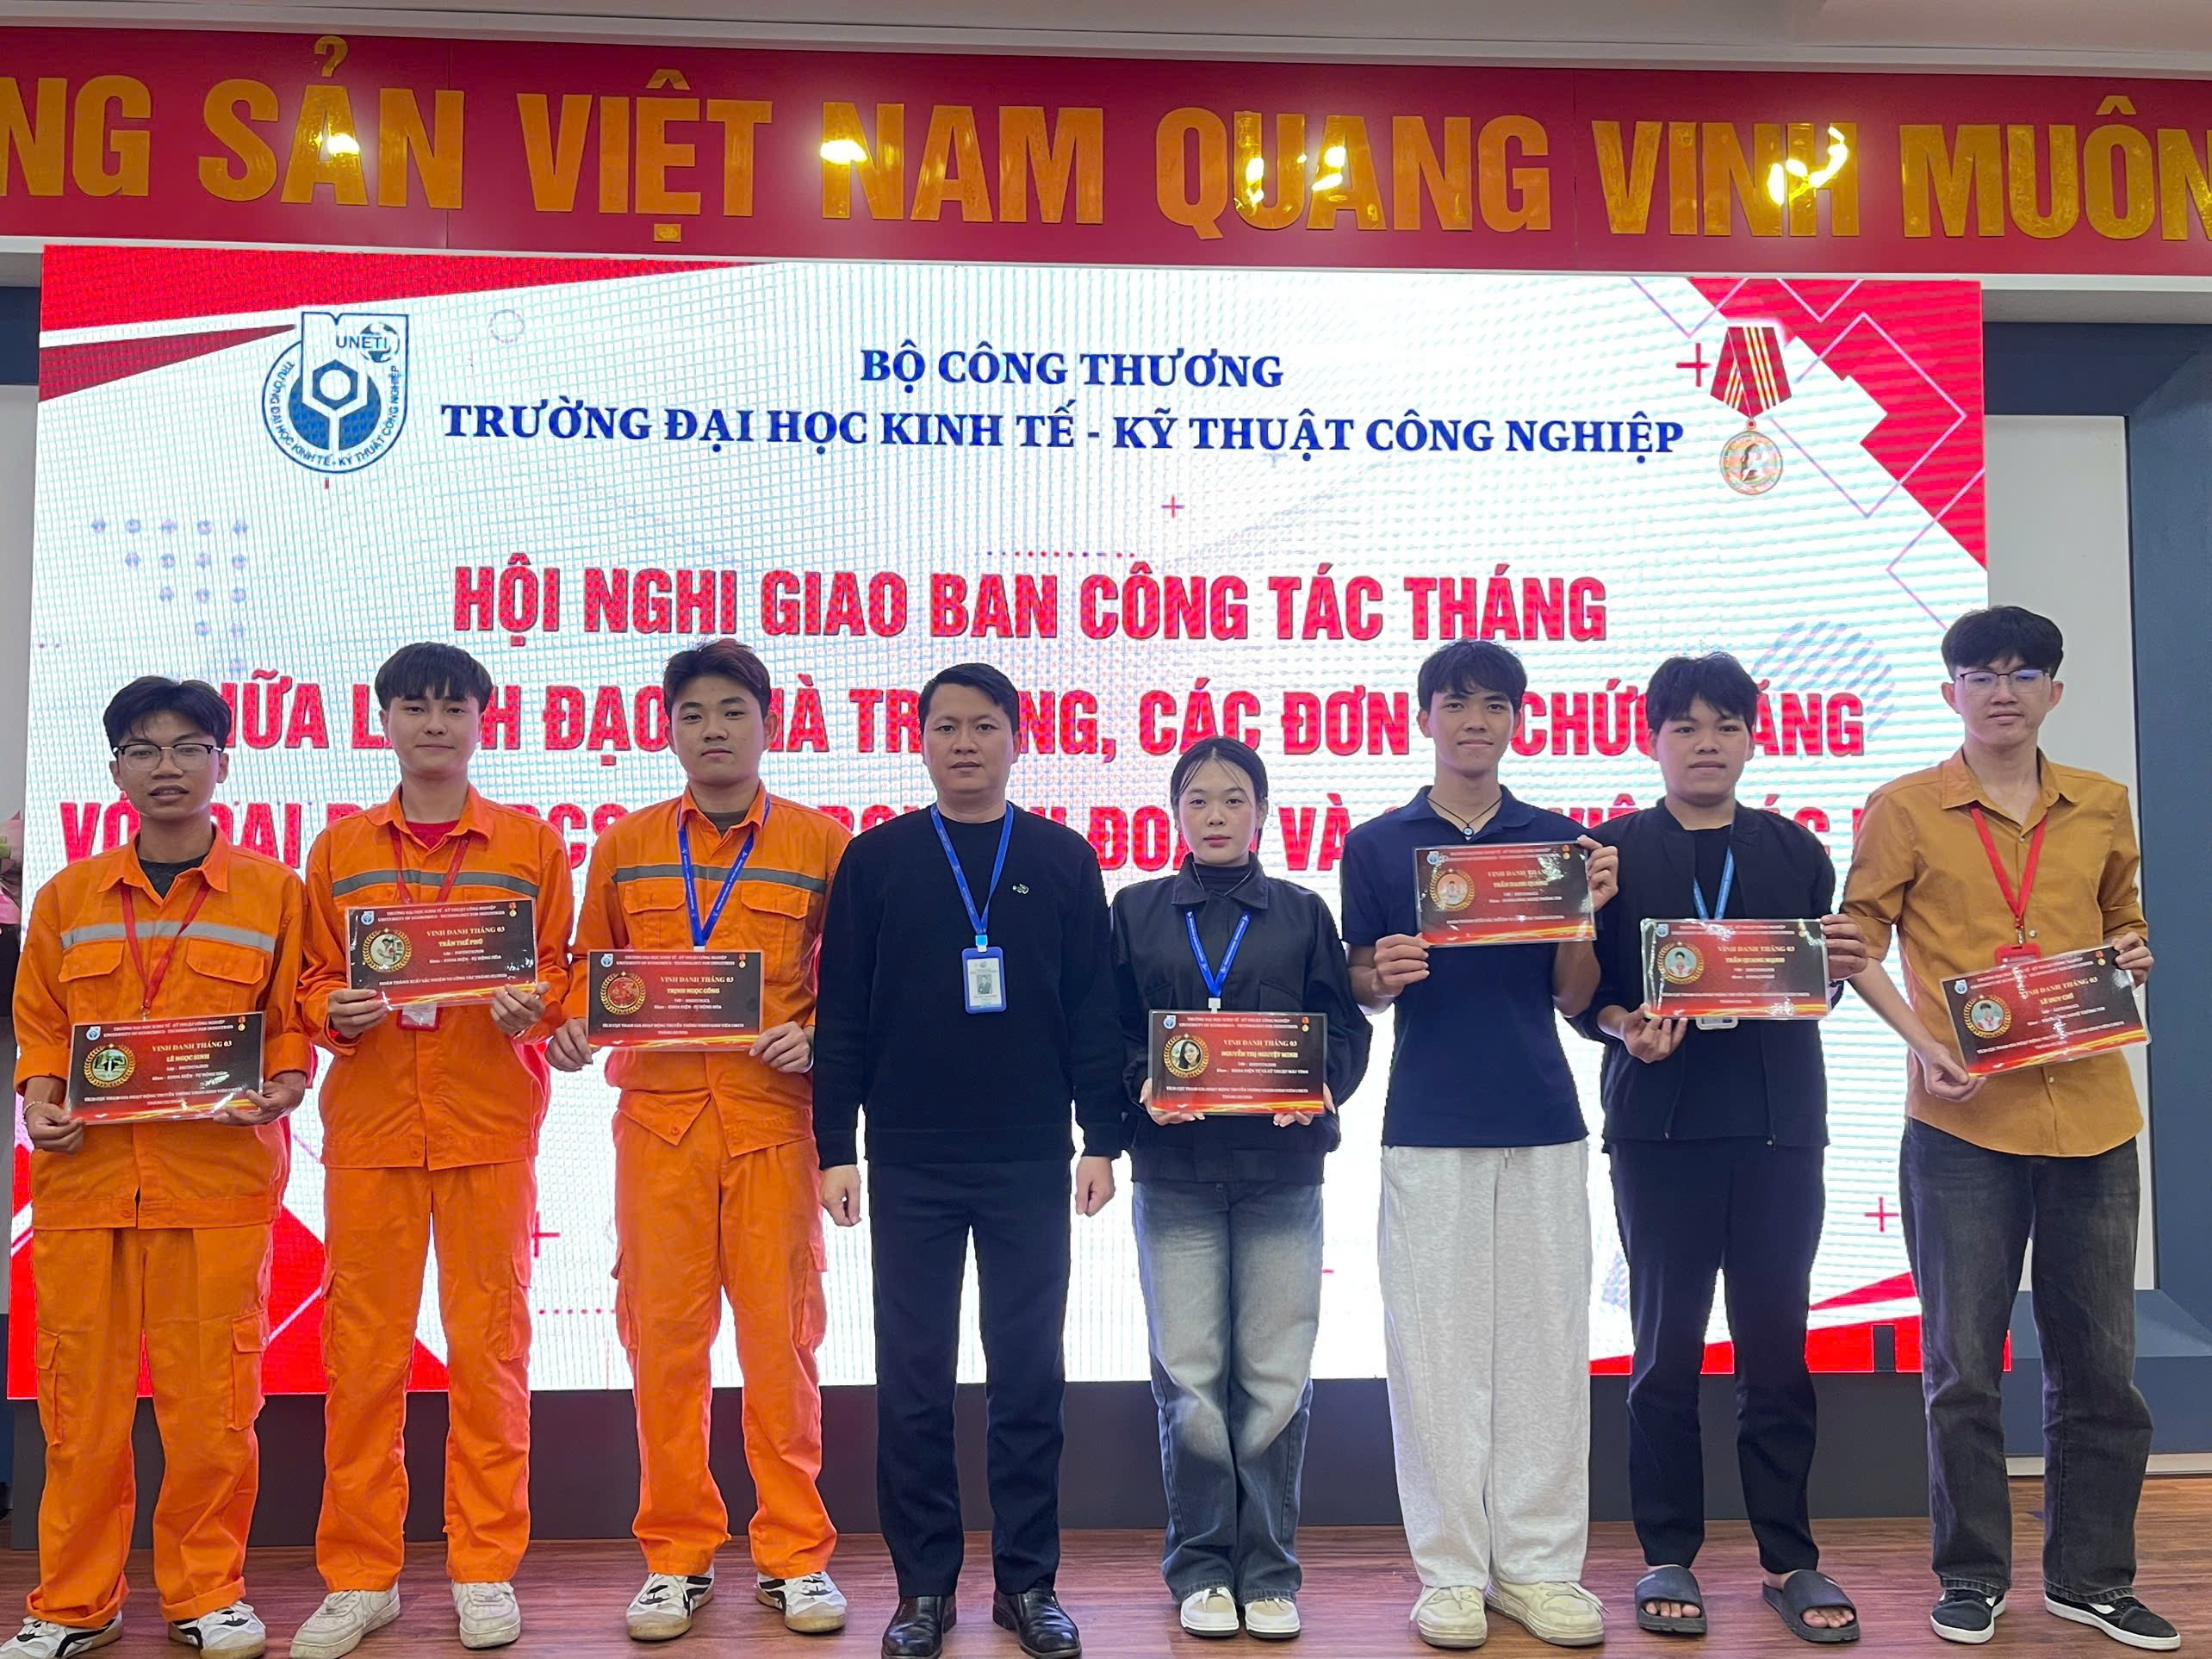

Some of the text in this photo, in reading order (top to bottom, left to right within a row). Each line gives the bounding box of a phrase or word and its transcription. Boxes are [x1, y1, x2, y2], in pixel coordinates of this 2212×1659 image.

[198, 35, 465, 210] SẢN
[517, 68, 773, 242] VIỆT
[820, 101, 1104, 225] NAM
[1155, 107, 1550, 240] QUANG
[1592, 120, 1860, 238] VINH
[335, 334, 388, 349] UNETI
[861, 339, 1283, 394] BỘ CÔNG THƯƠNG
[441, 396, 652, 440] TRƯỜNG
[664, 408, 754, 453] ĐẠI
[767, 410, 867, 455] HỌC
[881, 413, 1003, 447] KINH
[1016, 399, 1077, 448] TẾ
[1113, 407, 1178, 449] KỸ
[1189, 408, 1354, 462] THUẬT
[1366, 409, 1494, 452] CÔNG
[1506, 411, 1684, 464] NGHIỆP
[454, 553, 559, 647] HỘI
[761, 569, 908, 637] GIAO
[930, 573, 1059, 638] BAN
[1080, 562, 1248, 640] CÔNG
[1269, 563, 1383, 641] TÁC
[1404, 563, 1606, 641] THÁNG
[543, 685, 670, 766] ĐẠO
[848, 688, 1117, 763] TRNG,
[1139, 678, 1261, 755] CÁC
[1281, 684, 1410, 756] ĐƠN
[1510, 679, 1649, 756] CHỨ
[1752, 678, 1865, 756] ĂNG
[1278, 792, 1351, 871] VÀ
[196, 1041, 222, 1049] THÁNG
